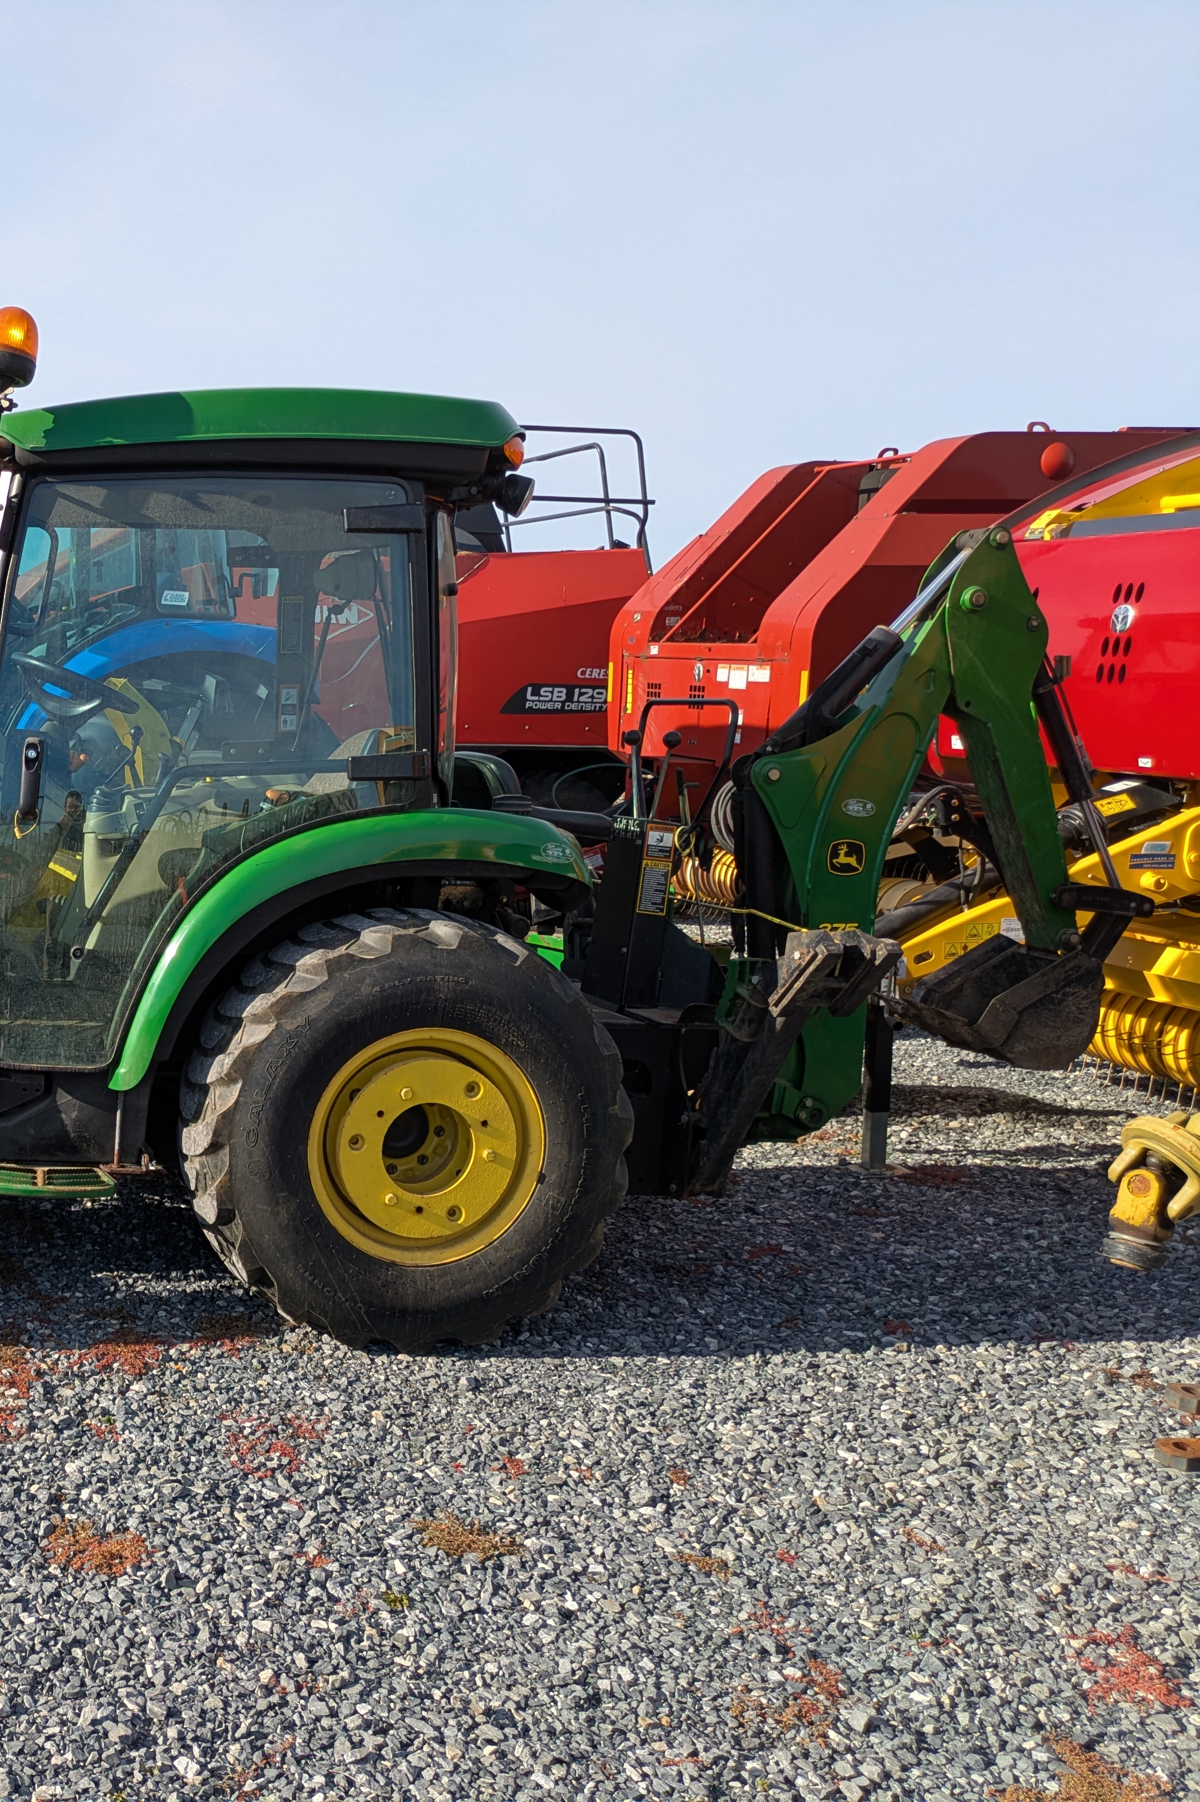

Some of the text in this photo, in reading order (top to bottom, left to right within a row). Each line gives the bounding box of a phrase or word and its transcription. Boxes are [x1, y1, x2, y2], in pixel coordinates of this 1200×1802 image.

[577, 667, 609, 679] CERE
[526, 687, 567, 702] LSB
[525, 701, 608, 711] POWER DENSITY
[384, 977, 412, 990] PLY
[416, 975, 468, 984] RATING
[245, 1014, 310, 1148] GALAXY
